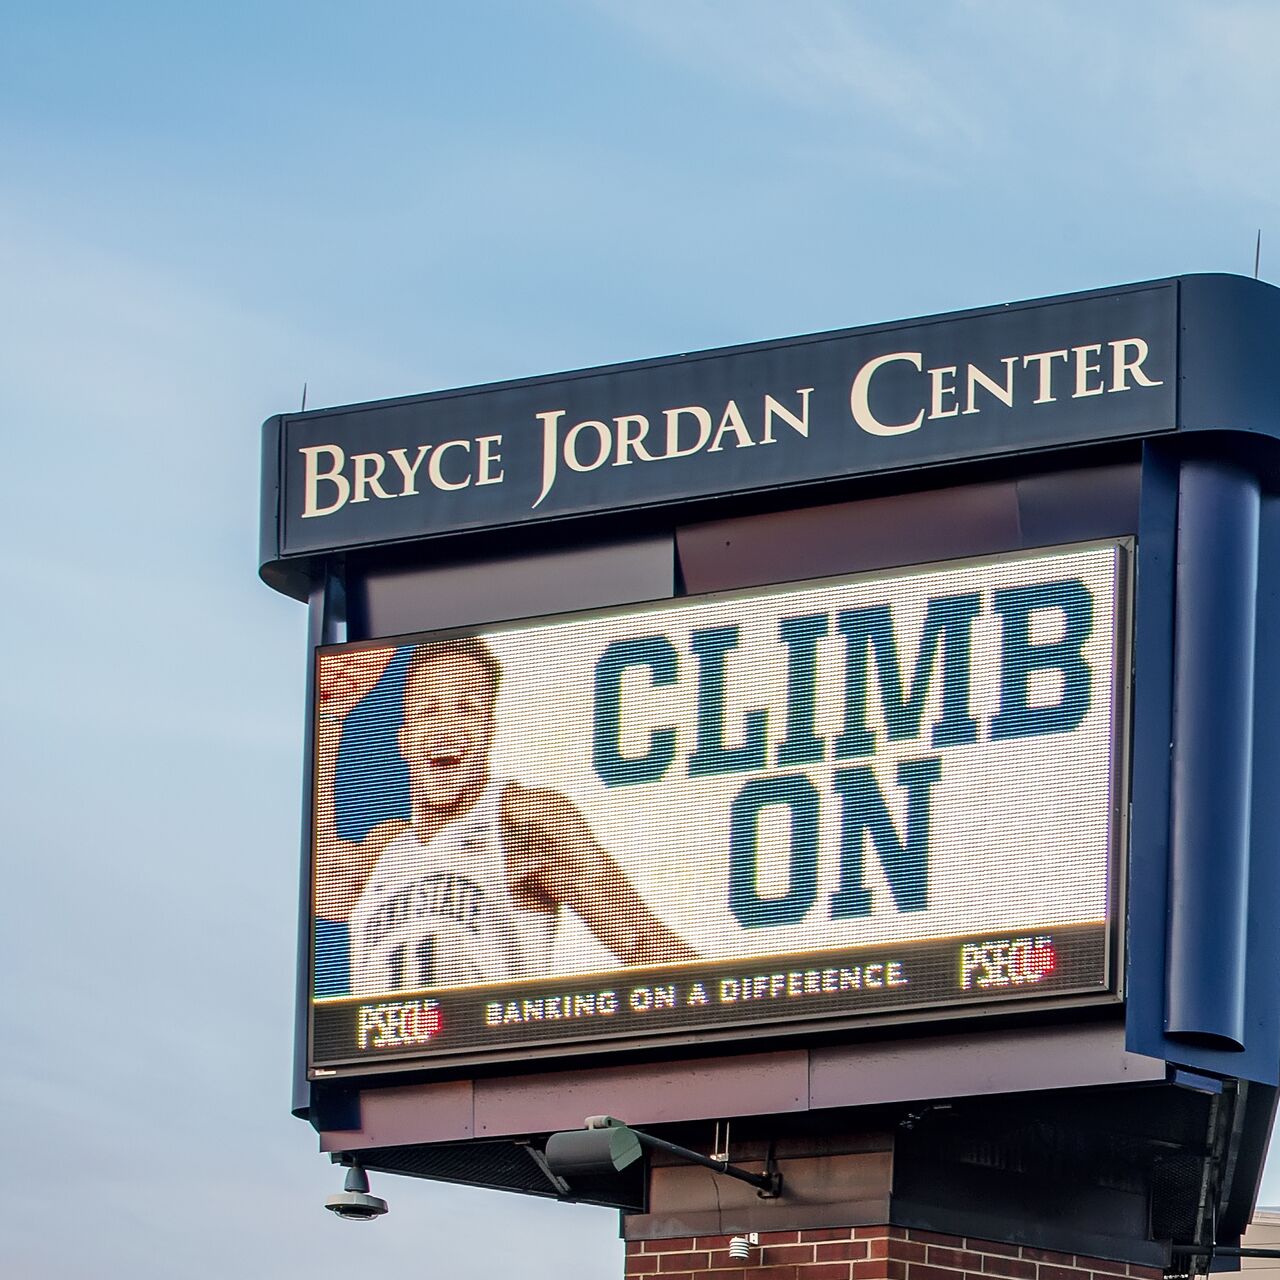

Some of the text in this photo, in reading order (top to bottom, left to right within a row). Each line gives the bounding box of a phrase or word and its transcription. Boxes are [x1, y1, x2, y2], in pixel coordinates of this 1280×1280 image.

[298, 336, 1164, 519] BRYCE JORDAN CENTER
[591, 578, 1095, 789] CLIMB
[729, 756, 943, 930] ON
[485, 991, 620, 1026] BANKING
[629, 985, 676, 1012] ON
[686, 982, 710, 1006] A
